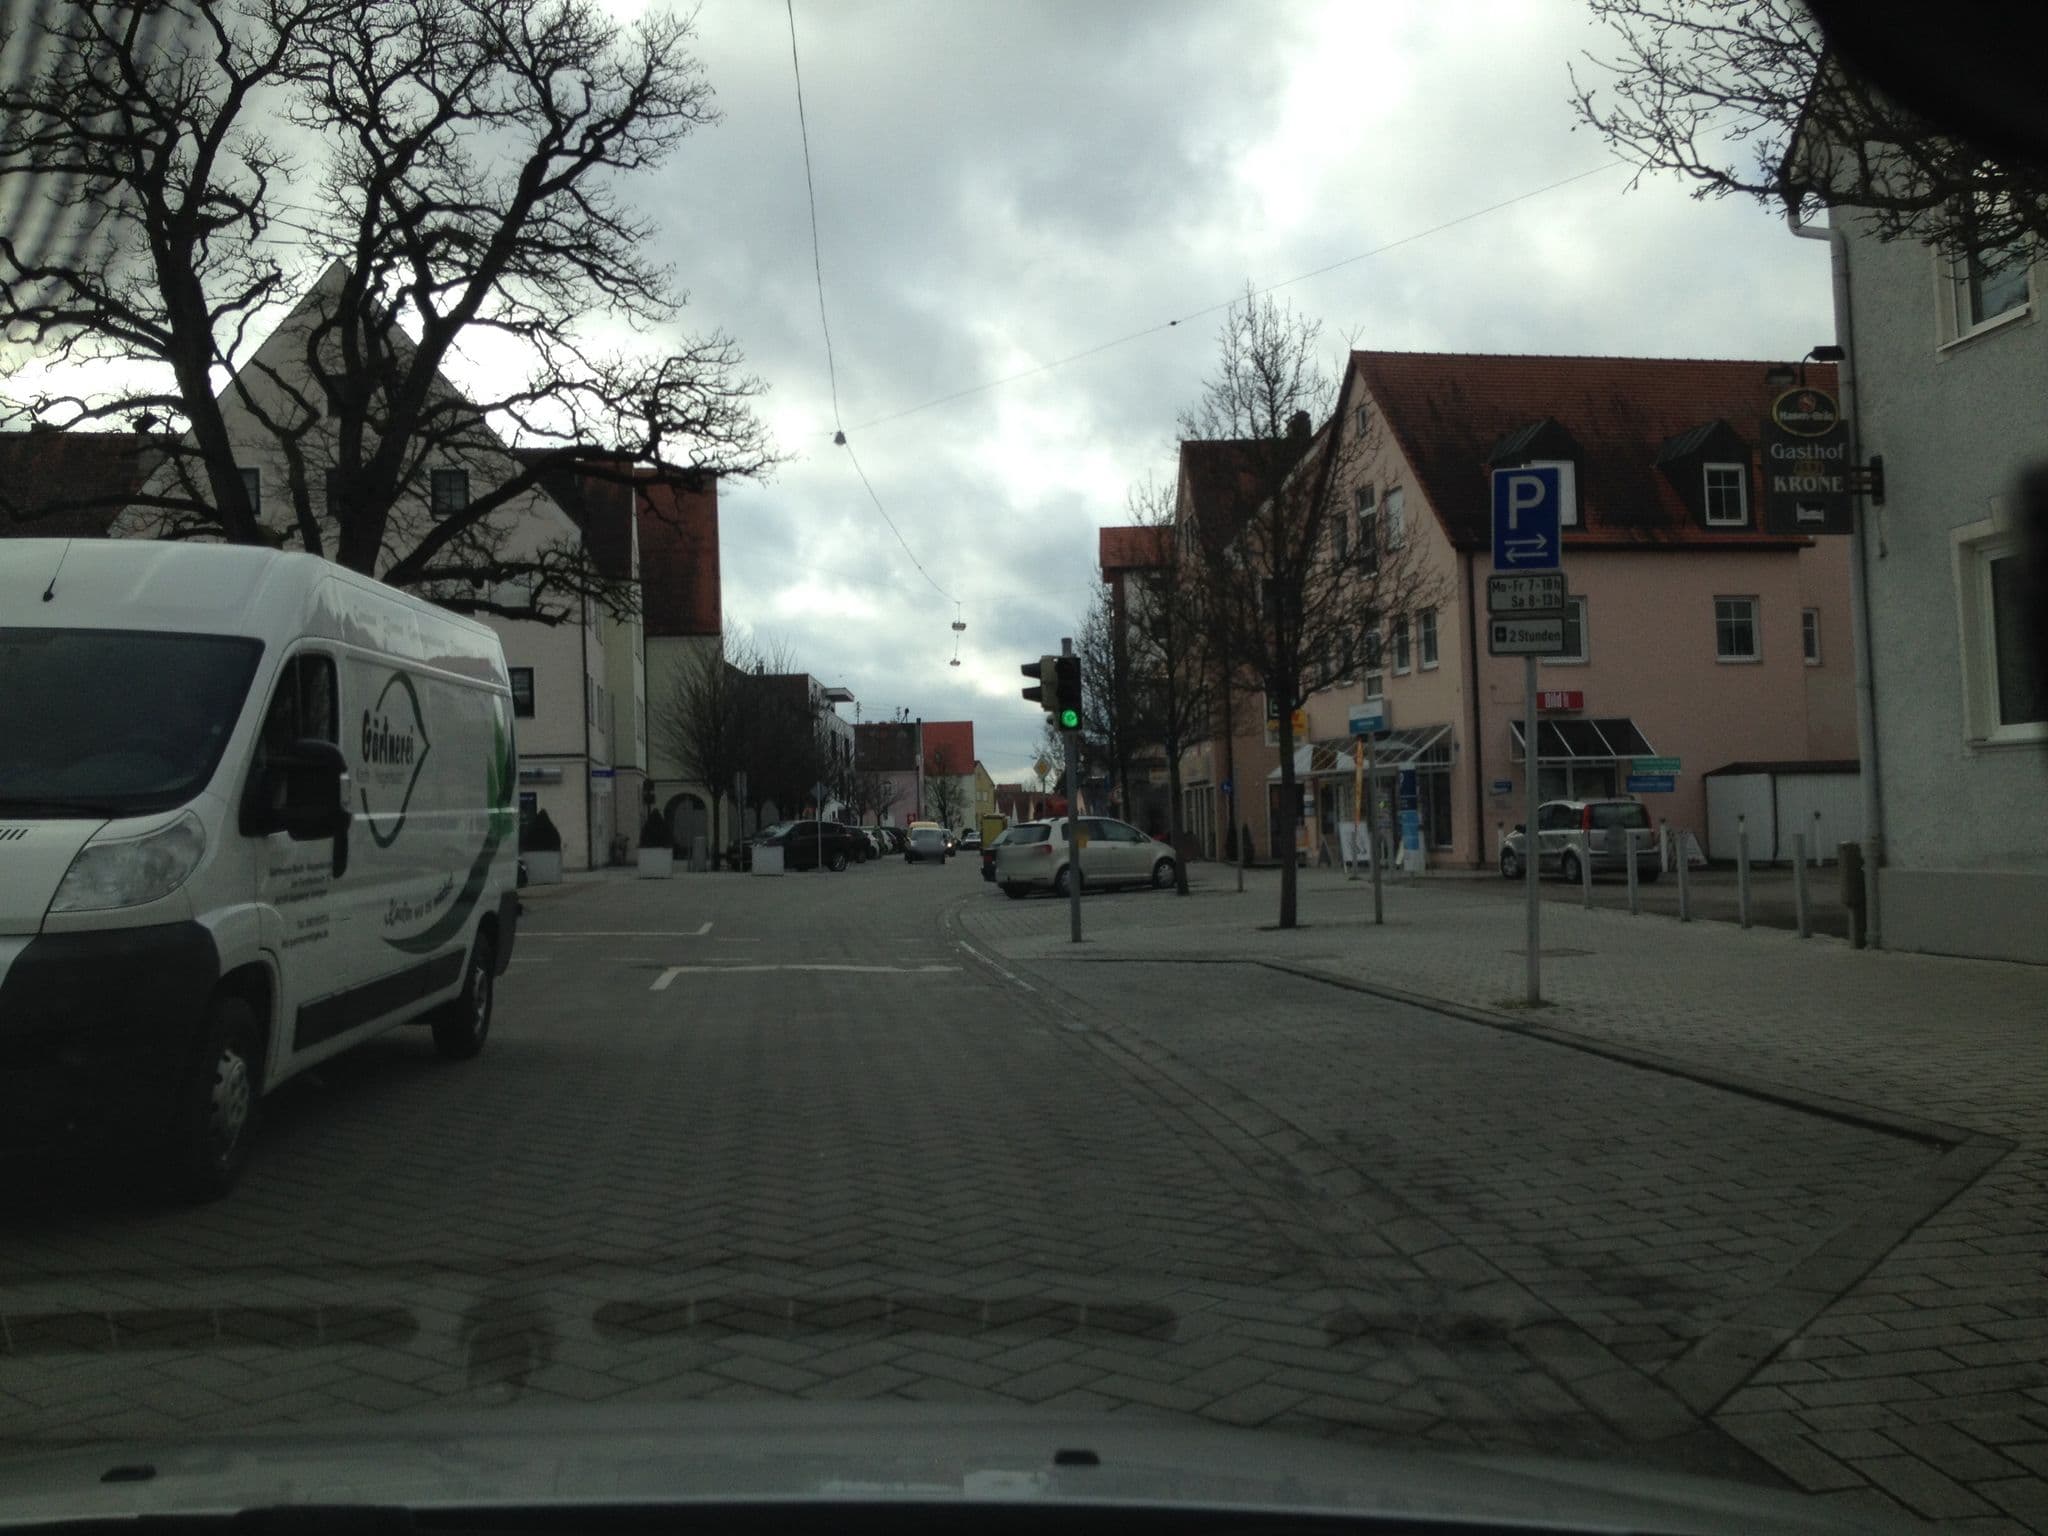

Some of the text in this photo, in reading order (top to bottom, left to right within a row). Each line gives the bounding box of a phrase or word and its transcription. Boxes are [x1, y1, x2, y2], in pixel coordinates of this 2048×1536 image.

[1770, 442, 1848, 460] Gasthof
[1773, 476, 1844, 492] KRONE
[1508, 476, 1546, 529] P
[1511, 595, 1525, 608] Sa
[1509, 629, 1561, 642] 2 Stunden
[362, 709, 414, 765] Gärtnerei
